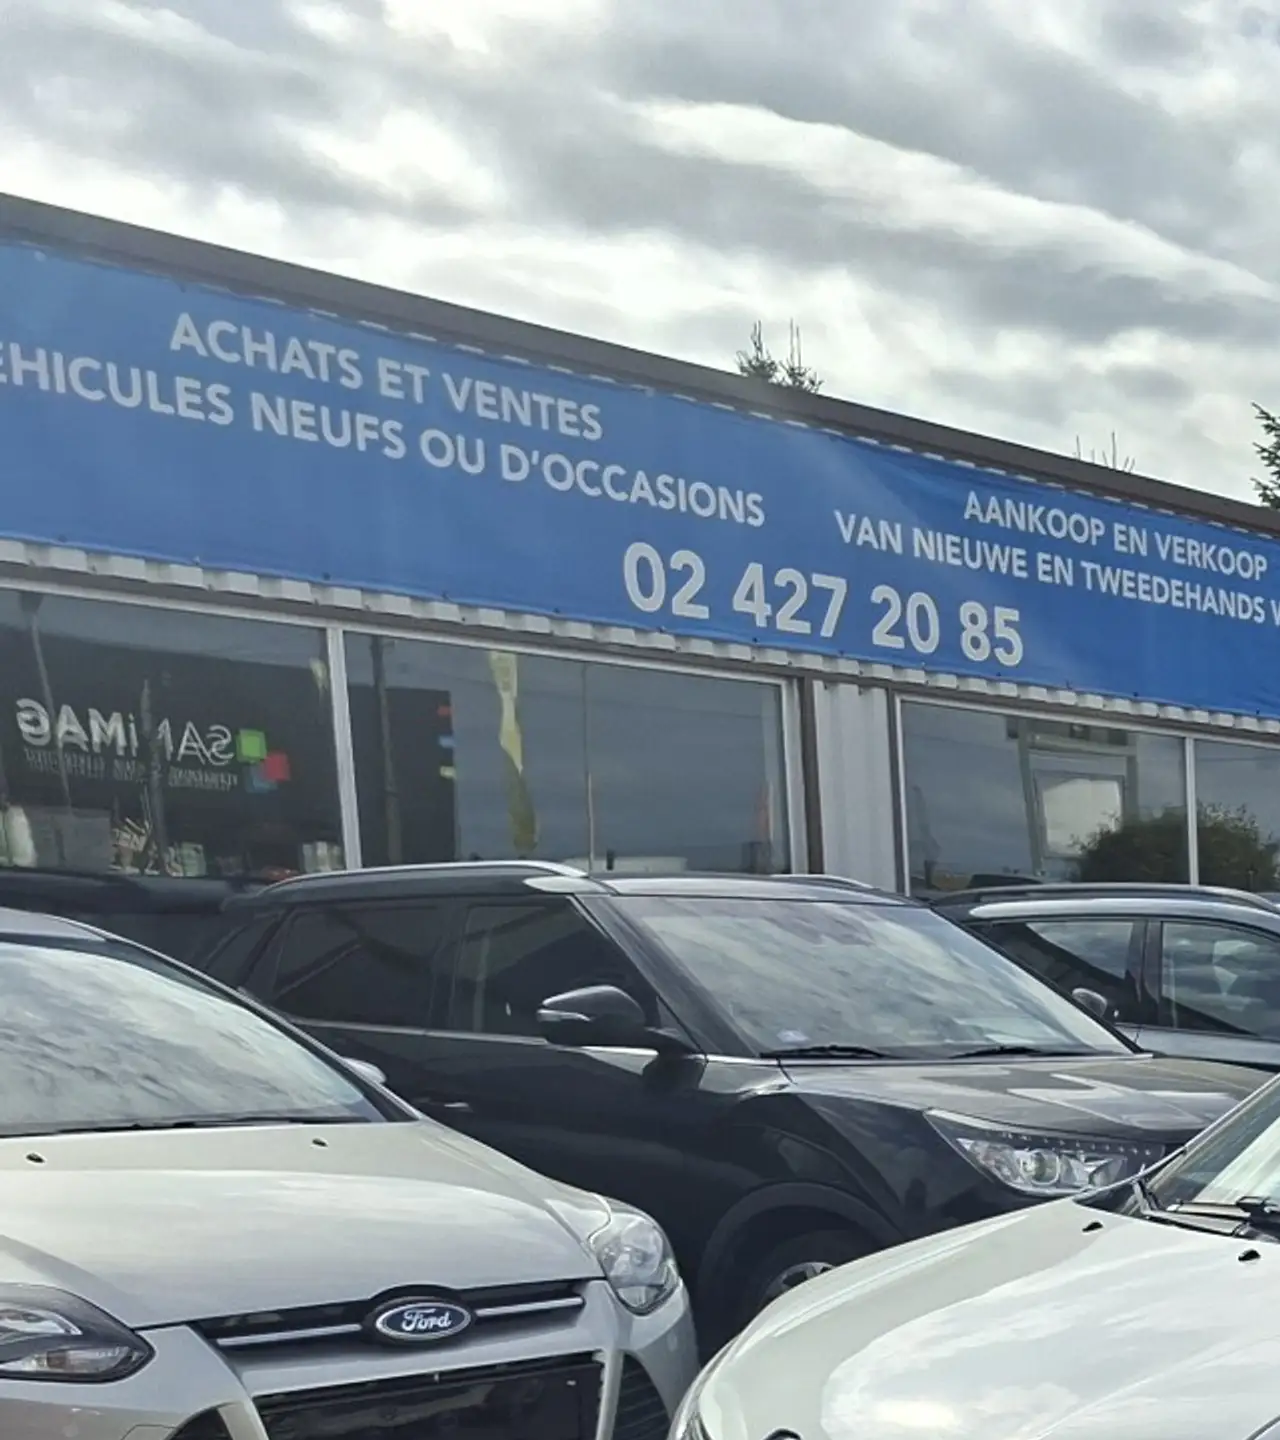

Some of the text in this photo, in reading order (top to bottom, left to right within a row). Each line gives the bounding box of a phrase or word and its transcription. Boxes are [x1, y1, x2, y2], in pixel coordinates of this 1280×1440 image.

[169, 312, 603, 441] ACHATS ET VENTES
[250, 391, 406, 459] NEUFS
[419, 428, 485, 474] OU
[499, 443, 765, 527] D'OCCASIONS
[834, 510, 903, 554] VAN
[911, 527, 1028, 578] NIEUWE
[1037, 551, 1074, 587] EN
[1080, 560, 1266, 624] TWEEDEHANDS
[963, 490, 1268, 581] AANKOOP EN VERKOOP
[623, 542, 1024, 667] 02 427 20 85
[401, 1308, 453, 1331] Ford
